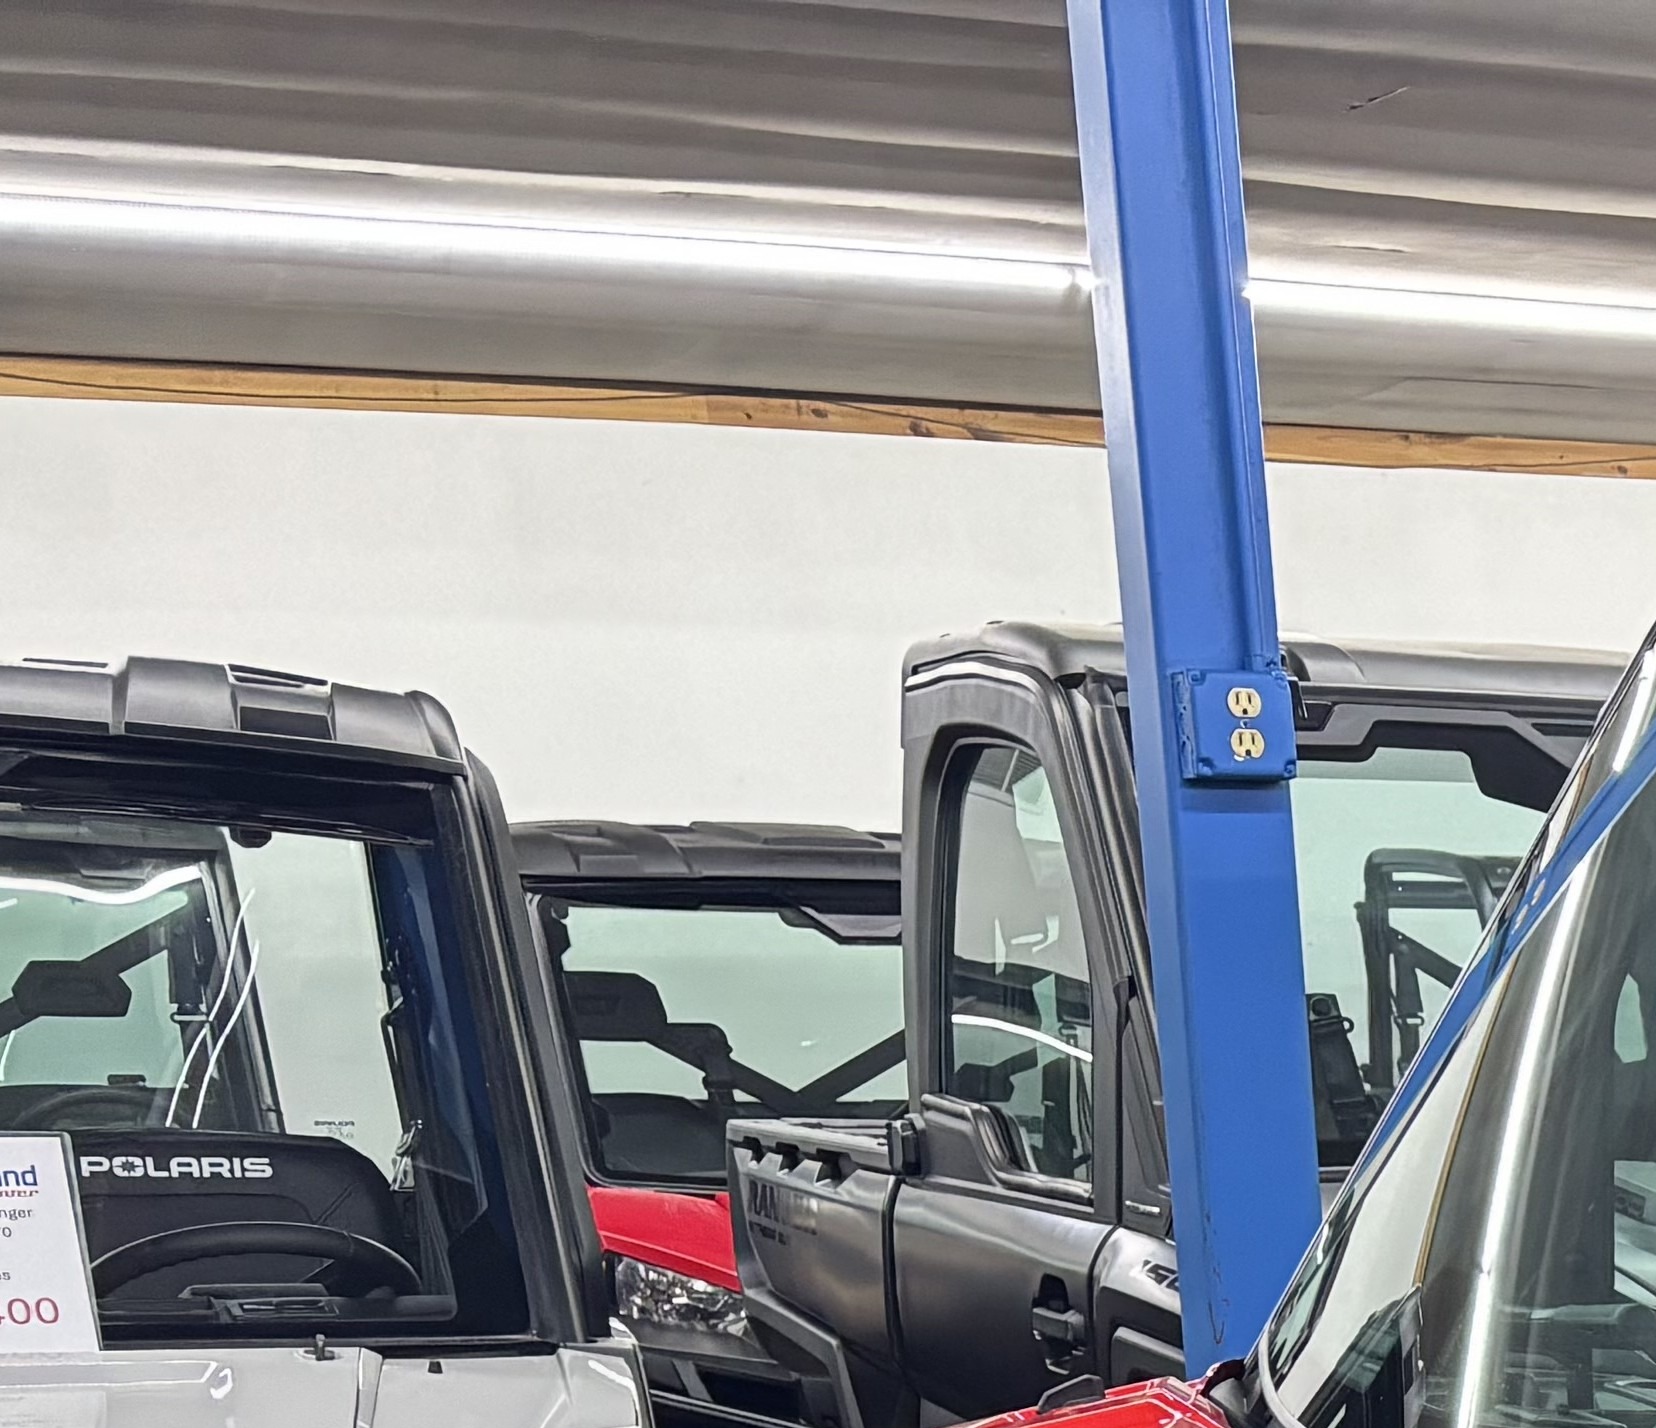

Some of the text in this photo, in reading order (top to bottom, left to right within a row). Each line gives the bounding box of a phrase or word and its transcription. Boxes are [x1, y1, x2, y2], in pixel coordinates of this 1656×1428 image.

[0, 1164, 39, 1187] nd
[79, 1155, 274, 1179] POLARIS
[0, 1208, 33, 1221] nger
[0, 1297, 59, 1325] 00
